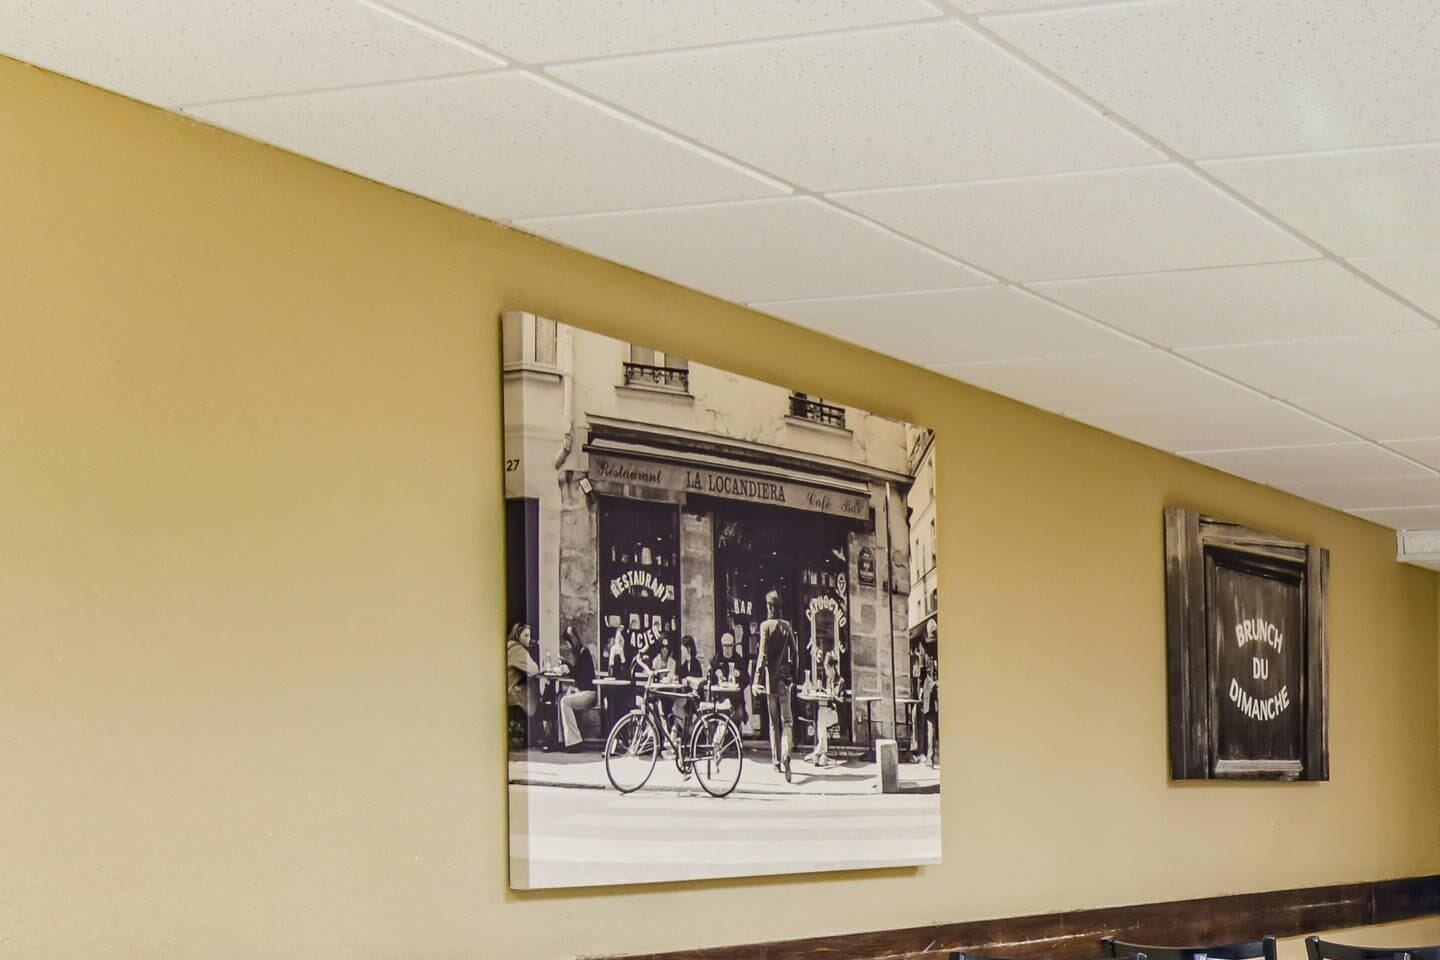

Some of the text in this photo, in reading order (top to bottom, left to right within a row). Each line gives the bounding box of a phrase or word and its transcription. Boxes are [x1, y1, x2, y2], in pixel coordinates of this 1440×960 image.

[506, 459, 520, 472] 27
[597, 460, 662, 483] Restaurant
[686, 471, 786, 503] LA LOCANDIERA
[610, 570, 673, 603] RESTAURANT
[733, 598, 753, 615] BAR
[1235, 617, 1283, 654] BRUNCH
[1252, 656, 1269, 680] DU
[1228, 677, 1290, 721] DIMANCHE
